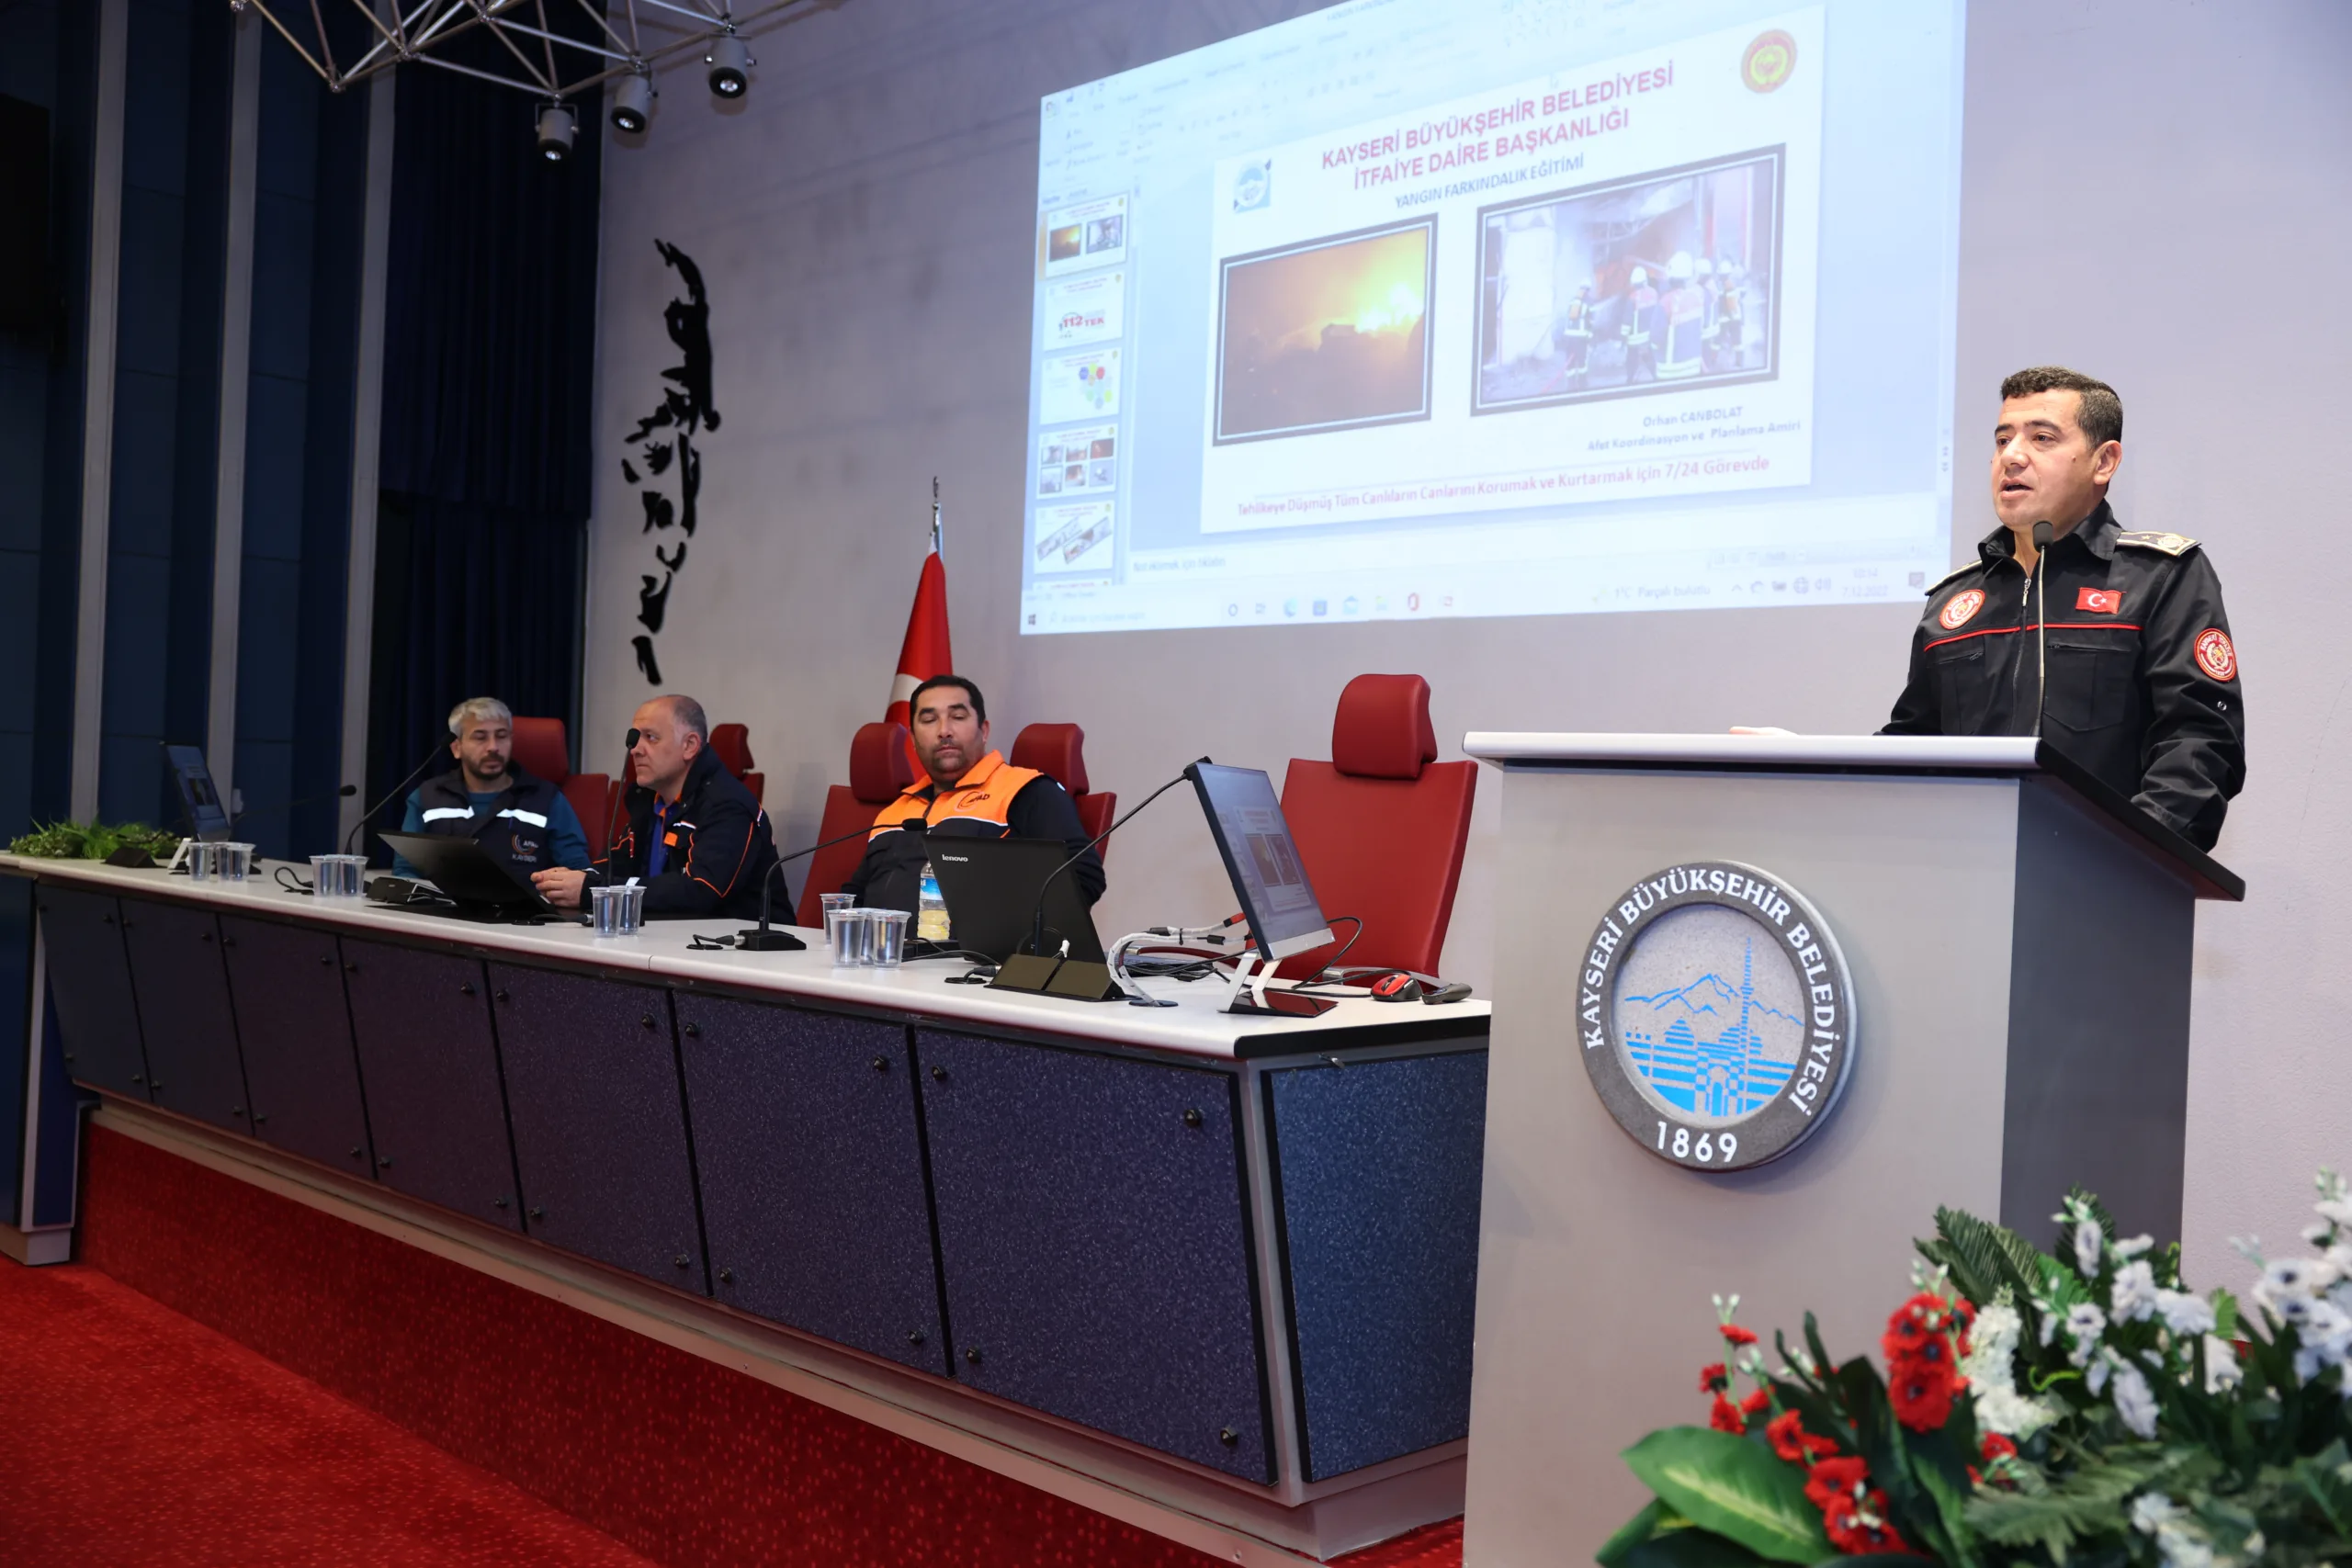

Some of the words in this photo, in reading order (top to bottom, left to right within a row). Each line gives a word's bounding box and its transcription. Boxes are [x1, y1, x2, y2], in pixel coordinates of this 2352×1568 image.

[1322, 130, 1400, 170] KAYSERİ
[1405, 97, 1536, 151] BÜYÜKŞEHİR
[1542, 60, 1674, 116] BELEDİYESİ
[1353, 156, 1424, 190] İTFAİYE
[1429, 141, 1489, 174] DAİRE
[1495, 105, 1630, 157] BAŞKANLIĞI
[1396, 187, 1442, 209] YANGIN
[1444, 167, 1528, 198] FARKINDALIK
[1531, 152, 1585, 181] EĞİTİMİ
[1587, 438, 1610, 452] Afet
[1611, 432, 1690, 450] Koordinasyon
[1690, 432, 1705, 443] ve
[1711, 424, 1765, 440] Planlama
[1768, 421, 1802, 434] Amiri
[1643, 413, 1679, 428] Orhan
[1680, 406, 1744, 425] CANBOLAT
[1288, 497, 1333, 513] Düşmüş
[1335, 493, 1360, 508] Tüm
[1362, 488, 1419, 505] Canlıların
[1420, 482, 1476, 501] Canlarını
[1477, 475, 1537, 496] Korumak
[1539, 477, 1555, 490] ve
[1558, 466, 1634, 488] Kurtarmak
[1636, 465, 1661, 485] için
[1665, 461, 1700, 482] 7/24
[1703, 455, 1770, 477] Görevde
[942, 853, 968, 863] lenovo
[1581, 916, 1623, 1049] KAYSERİ
[1619, 867, 1792, 927] BÜYÜKŞEHİR
[1786, 921, 1841, 1117] BELEDİYESİ
[1657, 1121, 1738, 1163] 1869
